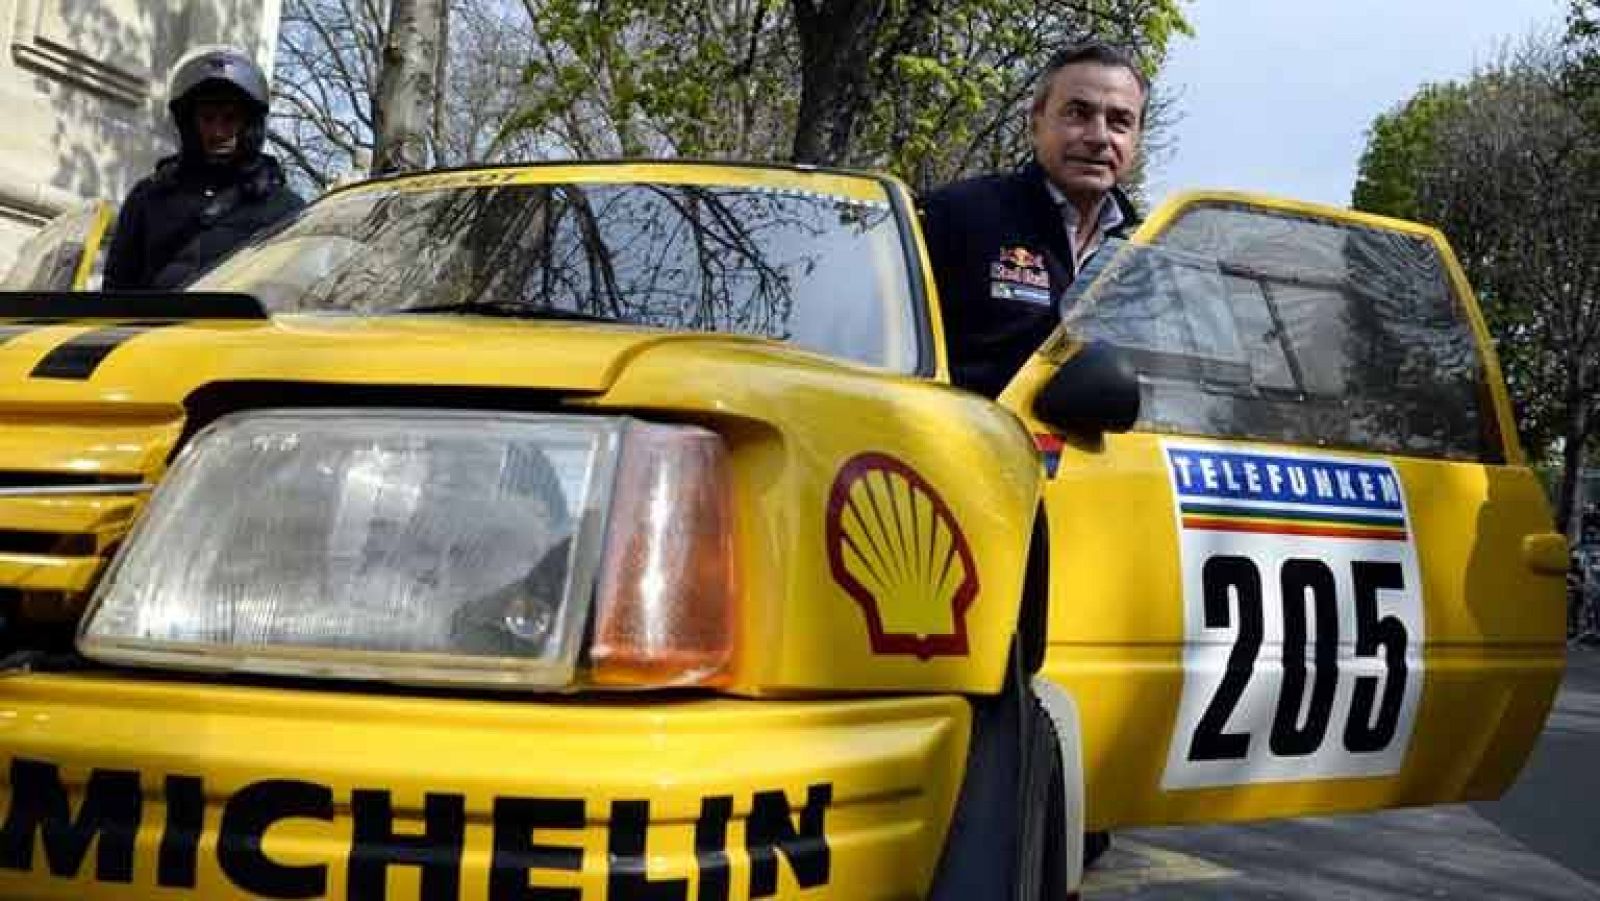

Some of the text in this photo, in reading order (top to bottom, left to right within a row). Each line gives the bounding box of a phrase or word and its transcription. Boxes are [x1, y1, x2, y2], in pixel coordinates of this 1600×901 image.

[1174, 456, 1400, 503] TELEFUNKEN
[1187, 555, 1409, 761] 205
[0, 757, 832, 901] MICHELIN
